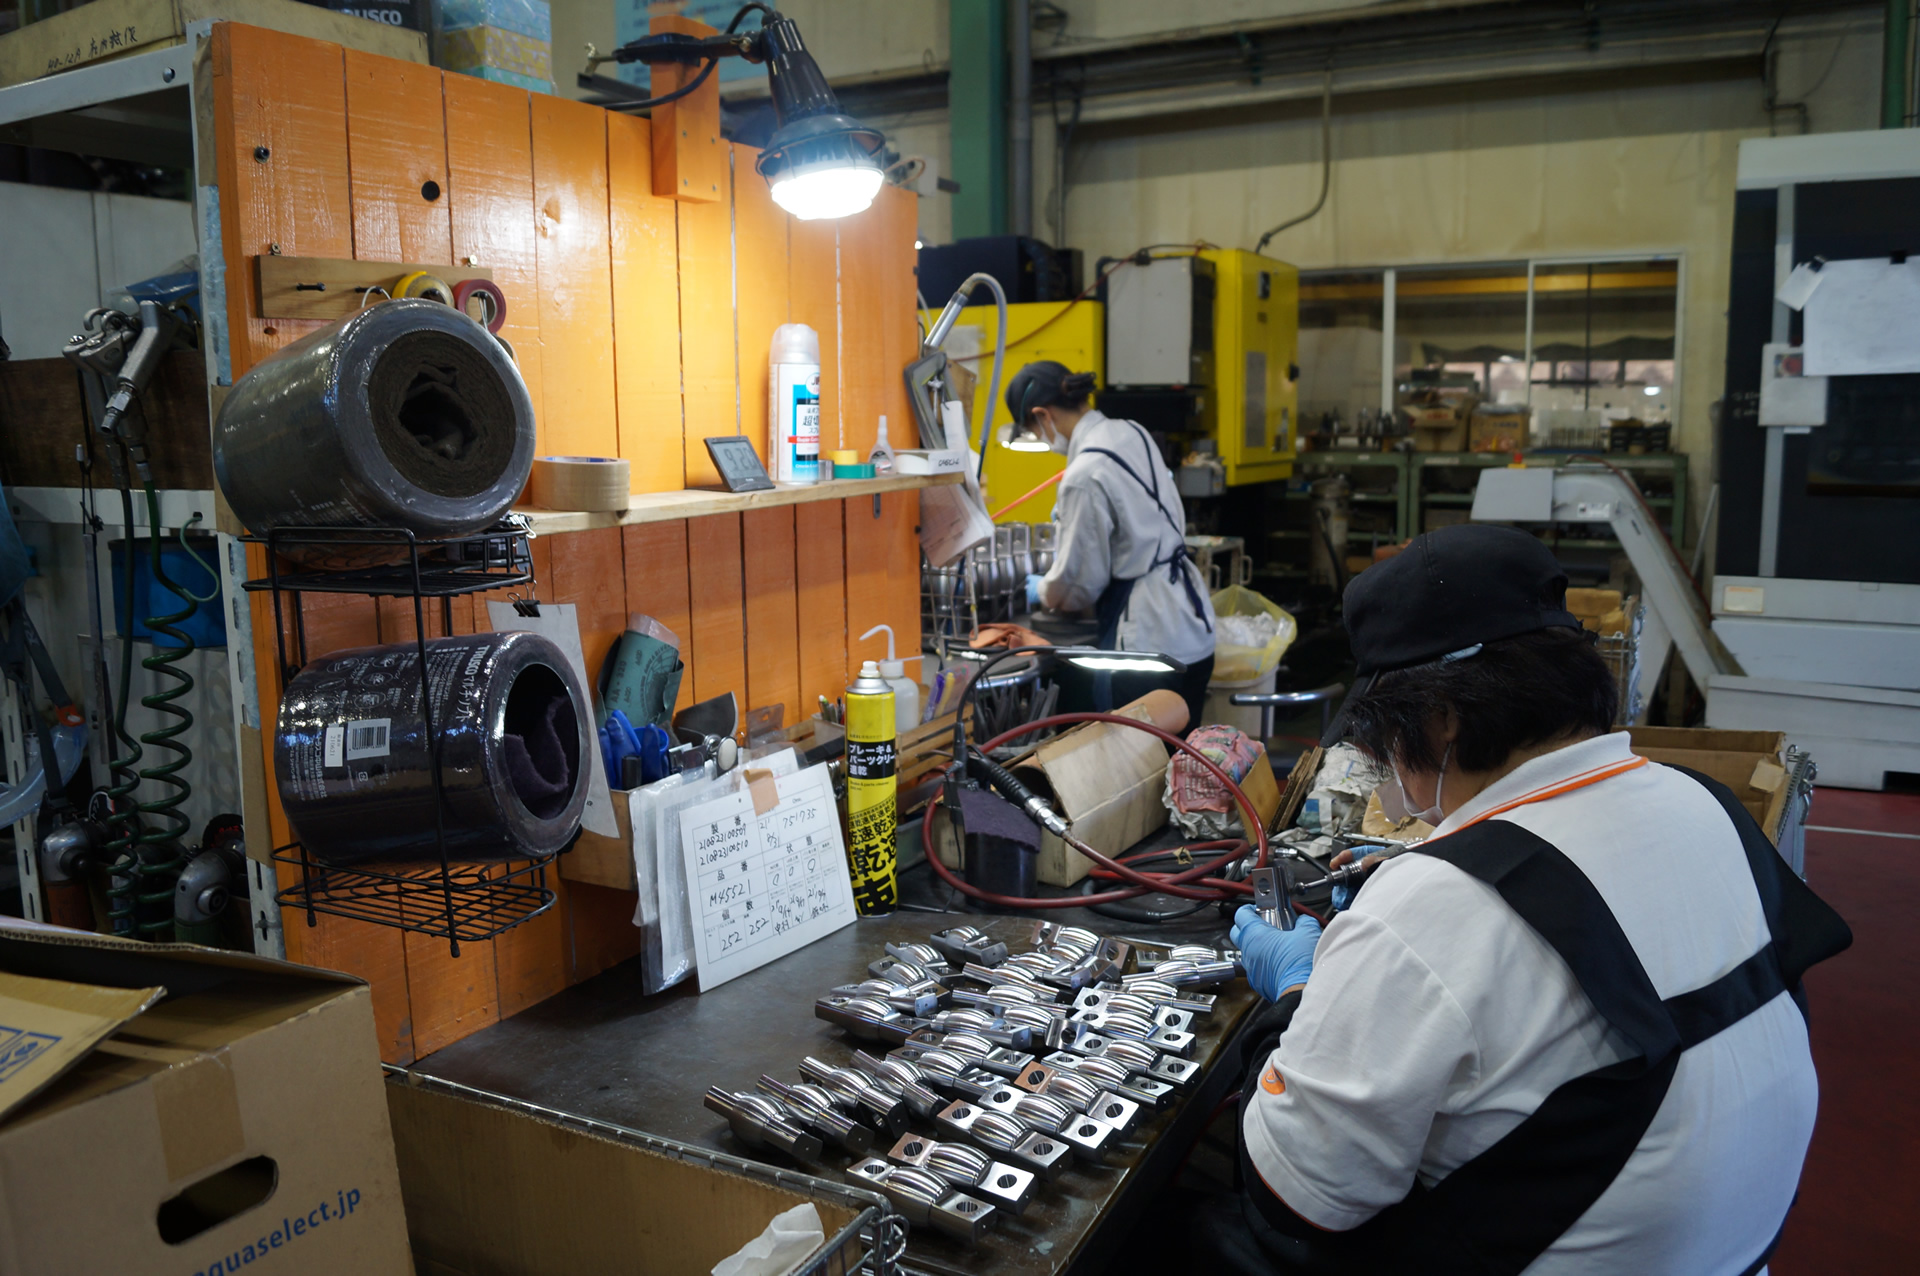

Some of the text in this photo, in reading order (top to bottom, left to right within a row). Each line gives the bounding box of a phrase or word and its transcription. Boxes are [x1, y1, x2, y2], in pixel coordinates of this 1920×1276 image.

[464, 645, 490, 676] TRUSCO
[709, 879, 752, 907] M45521
[749, 917, 770, 935] 252
[721, 932, 743, 951] 252
[193, 1188, 361, 1276] quaselect.jp
